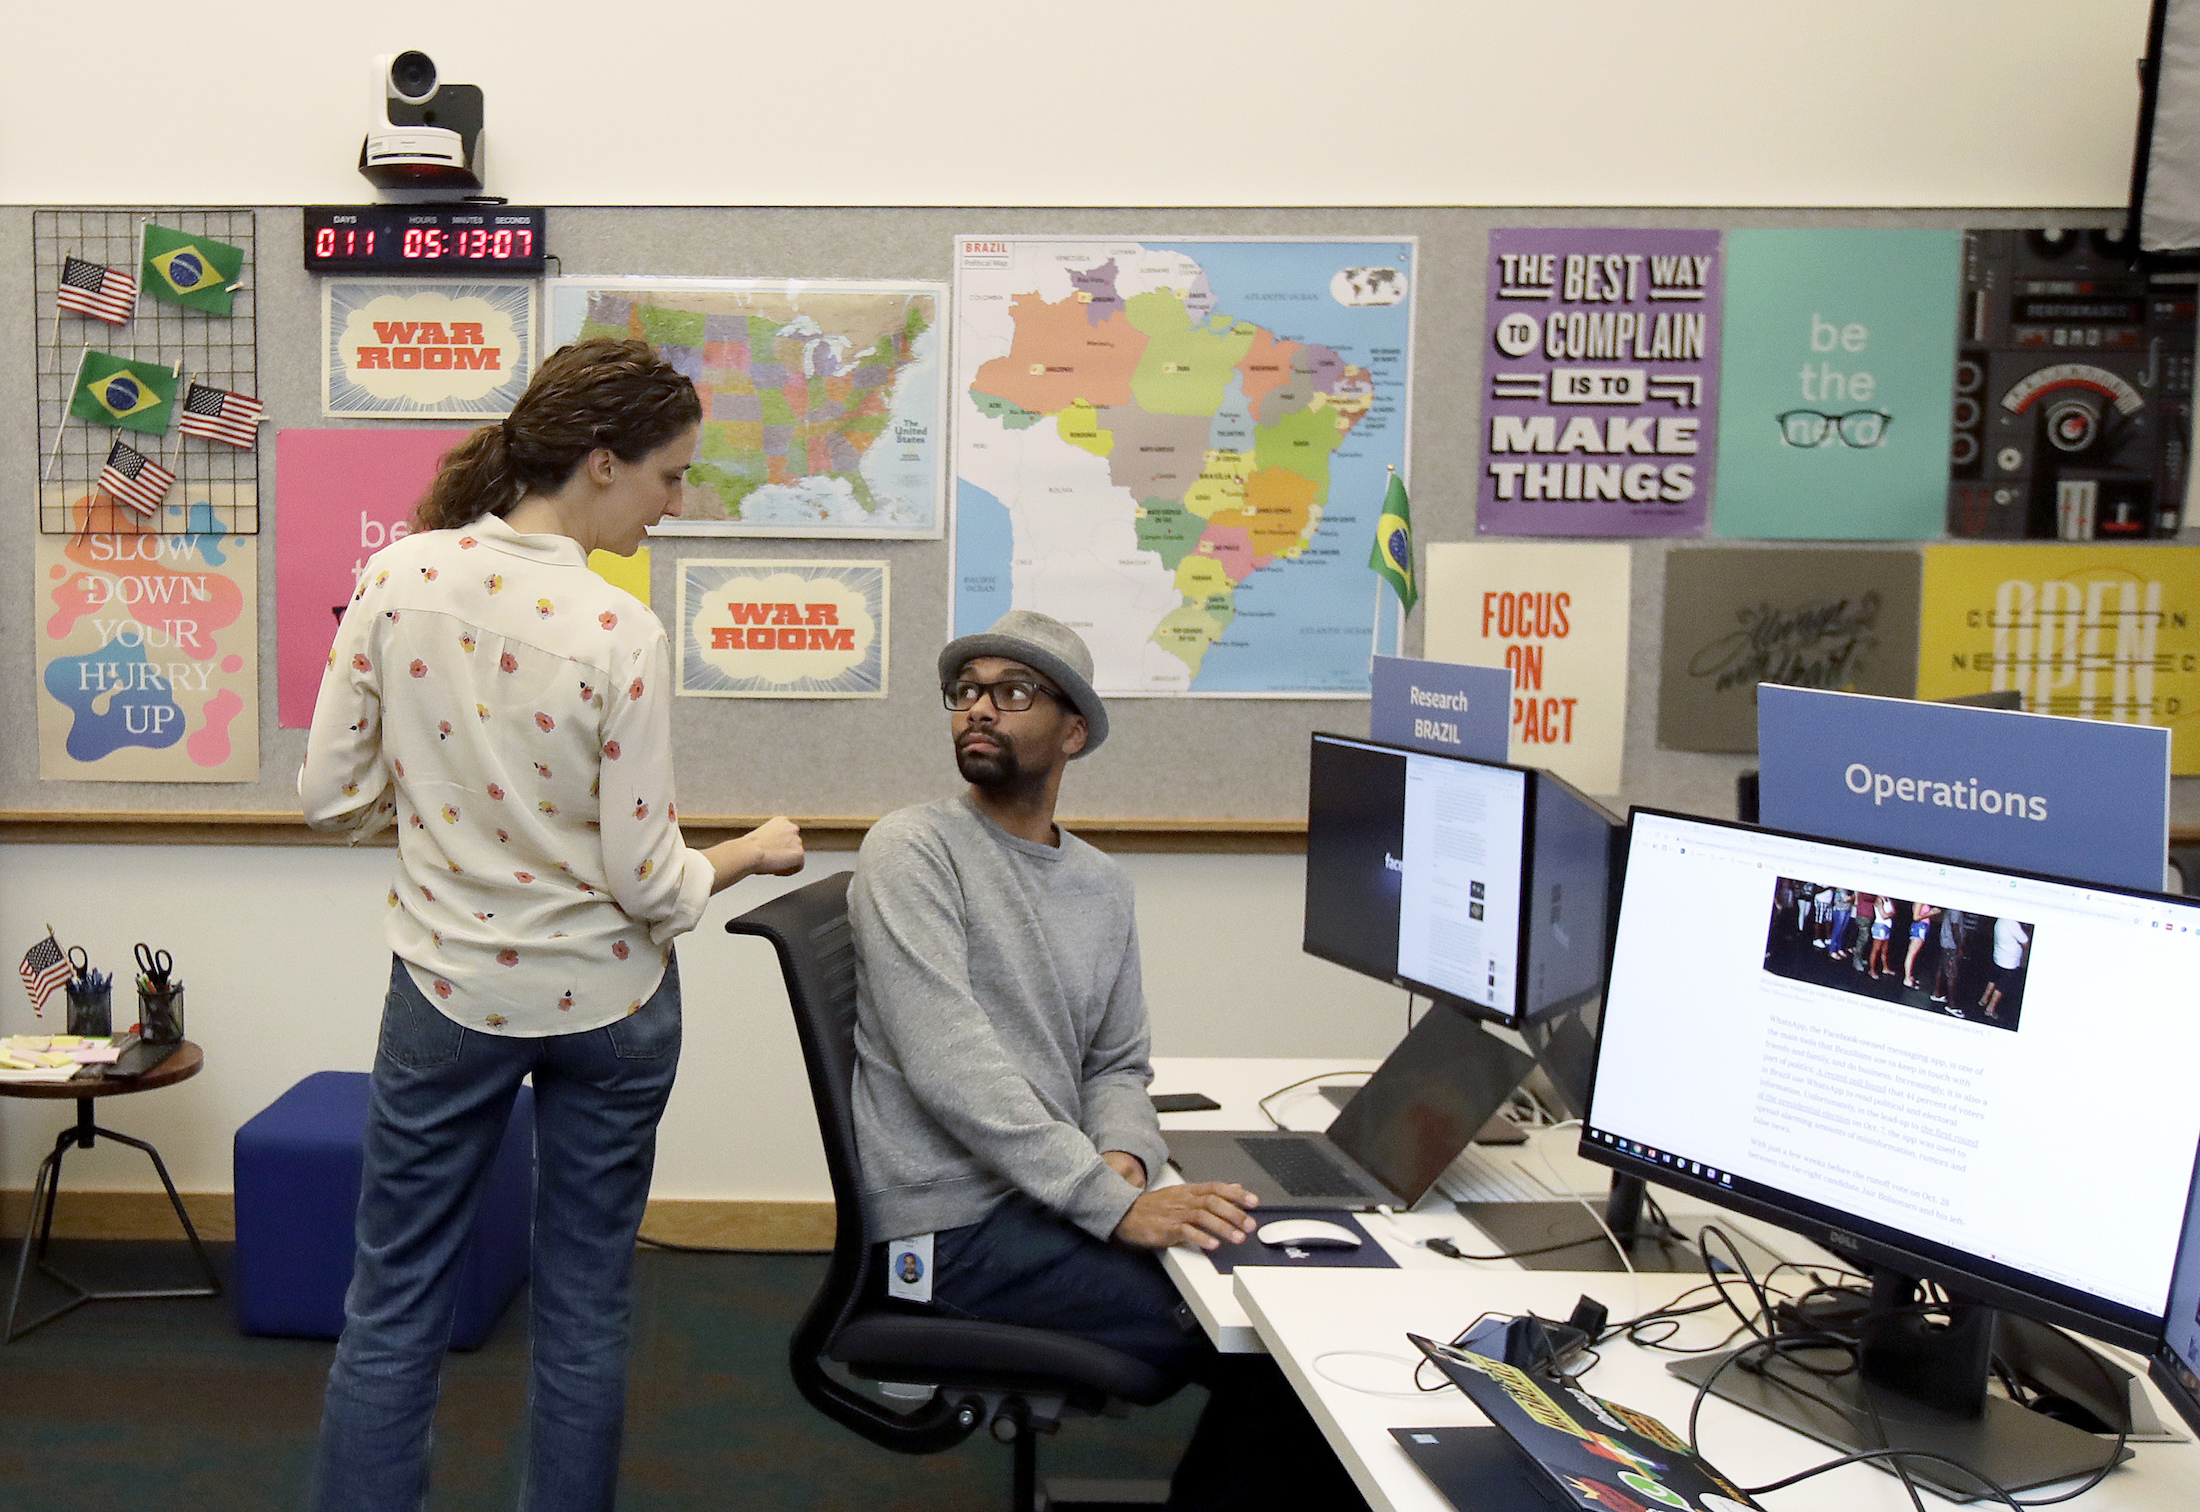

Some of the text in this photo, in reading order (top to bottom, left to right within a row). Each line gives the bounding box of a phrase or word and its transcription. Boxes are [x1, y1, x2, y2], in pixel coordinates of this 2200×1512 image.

[333, 216, 357, 224] DAYS
[409, 216, 531, 225] HOURS MINUTES SECONDS
[315, 227, 533, 259] 011 05:13:07
[966, 243, 1007, 253] BRAZIL
[964, 259, 1008, 268] Political Map
[1499, 254, 1712, 301] THE BEST WAY
[373, 322, 485, 345] WAR
[1507, 312, 1706, 359] TO COMPLAIN
[1811, 312, 1869, 353] be
[357, 347, 500, 370] ROOM
[1570, 377, 1629, 394] IS TO
[1800, 361, 1876, 401] the
[894, 427, 928, 435] United
[896, 435, 925, 444] States
[903, 419, 919, 427] The
[1492, 416, 1700, 454] MAKE
[1490, 463, 1696, 500] THINGS
[91, 533, 199, 561] SLOW
[360, 511, 409, 549] be
[87, 575, 207, 605] DOWN
[728, 603, 839, 626] WAR
[1481, 592, 1571, 638] FOCUS
[93, 619, 201, 649] YOUR
[711, 627, 855, 651] ROOM
[78, 662, 217, 691] HURRY
[1505, 645, 1543, 691] ON
[1410, 685, 1468, 713] Research
[123, 705, 176, 734] UP
[1414, 718, 1461, 745] BRAZIL
[1513, 698, 1578, 744] PACT
[1844, 763, 2048, 822] Operations
[1766, 1027, 1778, 1036] the
[1817, 1041, 1833, 1051] that
[1834, 1044, 1872, 1061] Brazilians
[1888, 1059, 1896, 1067] to
[1897, 1061, 1917, 1074] keep
[1927, 1069, 1950, 1082] touch
[1952, 1077, 1970, 1087] with
[1809, 1025, 1821, 1034] the
[1823, 1028, 1885, 1050] Facebook-owned
[1886, 1046, 1928, 1063] messaging
[1957, 1064, 1973, 1073] one
[1974, 1067, 1984, 1076] of
[1778, 1057, 1787, 1065] of
[1887, 1087, 1903, 1097] that
[1915, 1096, 1946, 1109] percent
[1948, 1104, 1957, 1112] of
[1958, 1107, 1984, 1119] voters
[1790, 1048, 1805, 1057] and
[1831, 1059, 1846, 1068] and
[1946, 1088, 1953, 1097] it
[1963, 1093, 1981, 1104] also
[1806, 1077, 1844, 1095] WhatsApp
[1845, 1089, 1853, 1097] to
[1854, 1093, 1872, 1103] read
[1873, 1098, 1904, 1111] political
[1905, 1107, 1921, 1116] and
[1921, 1111, 1957, 1126] electoral
[1755, 1105, 1779, 1116] spread
[1814, 1122, 1846, 1136] amounts
[1846, 1131, 1855, 1139] of
[1918, 1153, 1948, 1167] rumors
[1950, 1163, 1966, 1172] and
[1821, 1110, 1850, 1125] election
[1851, 1119, 1862, 1127] on
[1887, 1128, 1900, 1138] the
[1901, 1134, 1917, 1144] app
[1918, 1139, 1934, 1149] was
[1936, 1144, 1956, 1155] used
[1957, 1149, 1966, 1158] to
[1866, 1109, 1879, 1118] the
[1880, 1112, 1909, 1128] lead-up
[1910, 1121, 1919, 1130] to
[1920, 1124, 1934, 1135] the
[1934, 1127, 1952, 1140] first
[1953, 1135, 1979, 1147] round
[1747, 1150, 1777, 1165] between
[1778, 1160, 1790, 1169] the
[1791, 1164, 1821, 1179] far-right
[1823, 1176, 1859, 1191] candidate
[1860, 1186, 1876, 1197] Jair
[1877, 1191, 1917, 1210] Bolsonaro
[1918, 1206, 1934, 1216] and
[1935, 1209, 1948, 1220] his
[1803, 1156, 1826, 1168] weeks
[1826, 1161, 1851, 1175] before
[1852, 1170, 1864, 1180] the
[1865, 1175, 1890, 1188] runoff
[1891, 1183, 1908, 1193] vote
[1909, 1189, 1920, 1198] on
[1939, 1197, 1949, 1206] 28
